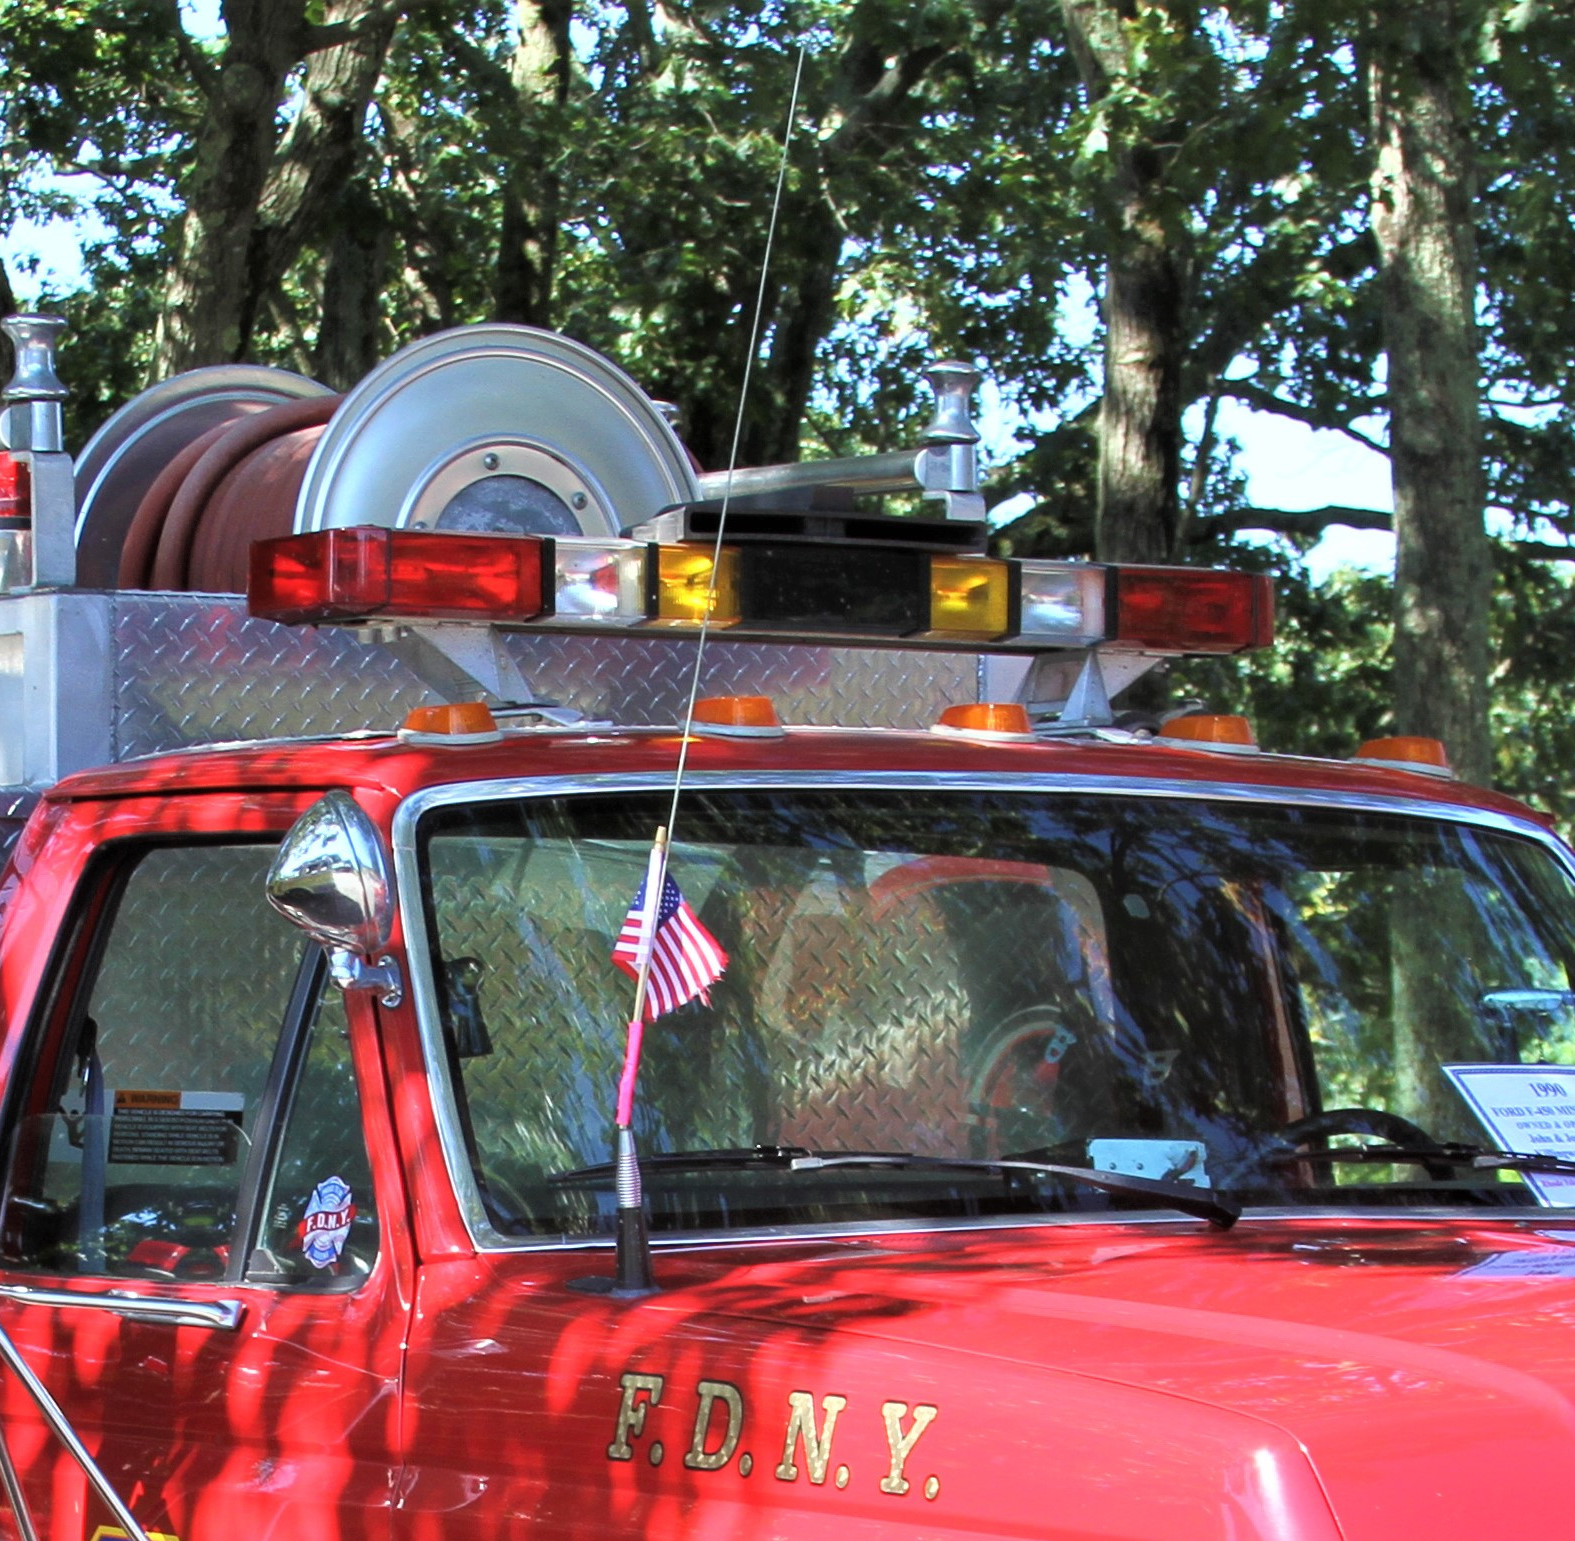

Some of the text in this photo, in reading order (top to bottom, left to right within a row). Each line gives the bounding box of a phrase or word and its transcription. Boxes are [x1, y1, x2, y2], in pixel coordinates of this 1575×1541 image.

[1528, 1082, 1568, 1098] 1990
[1491, 1107, 1528, 1118] FORD
[306, 1208, 351, 1233] F.D.N.Y.
[607, 1373, 940, 1501] F.D.N.Y.
